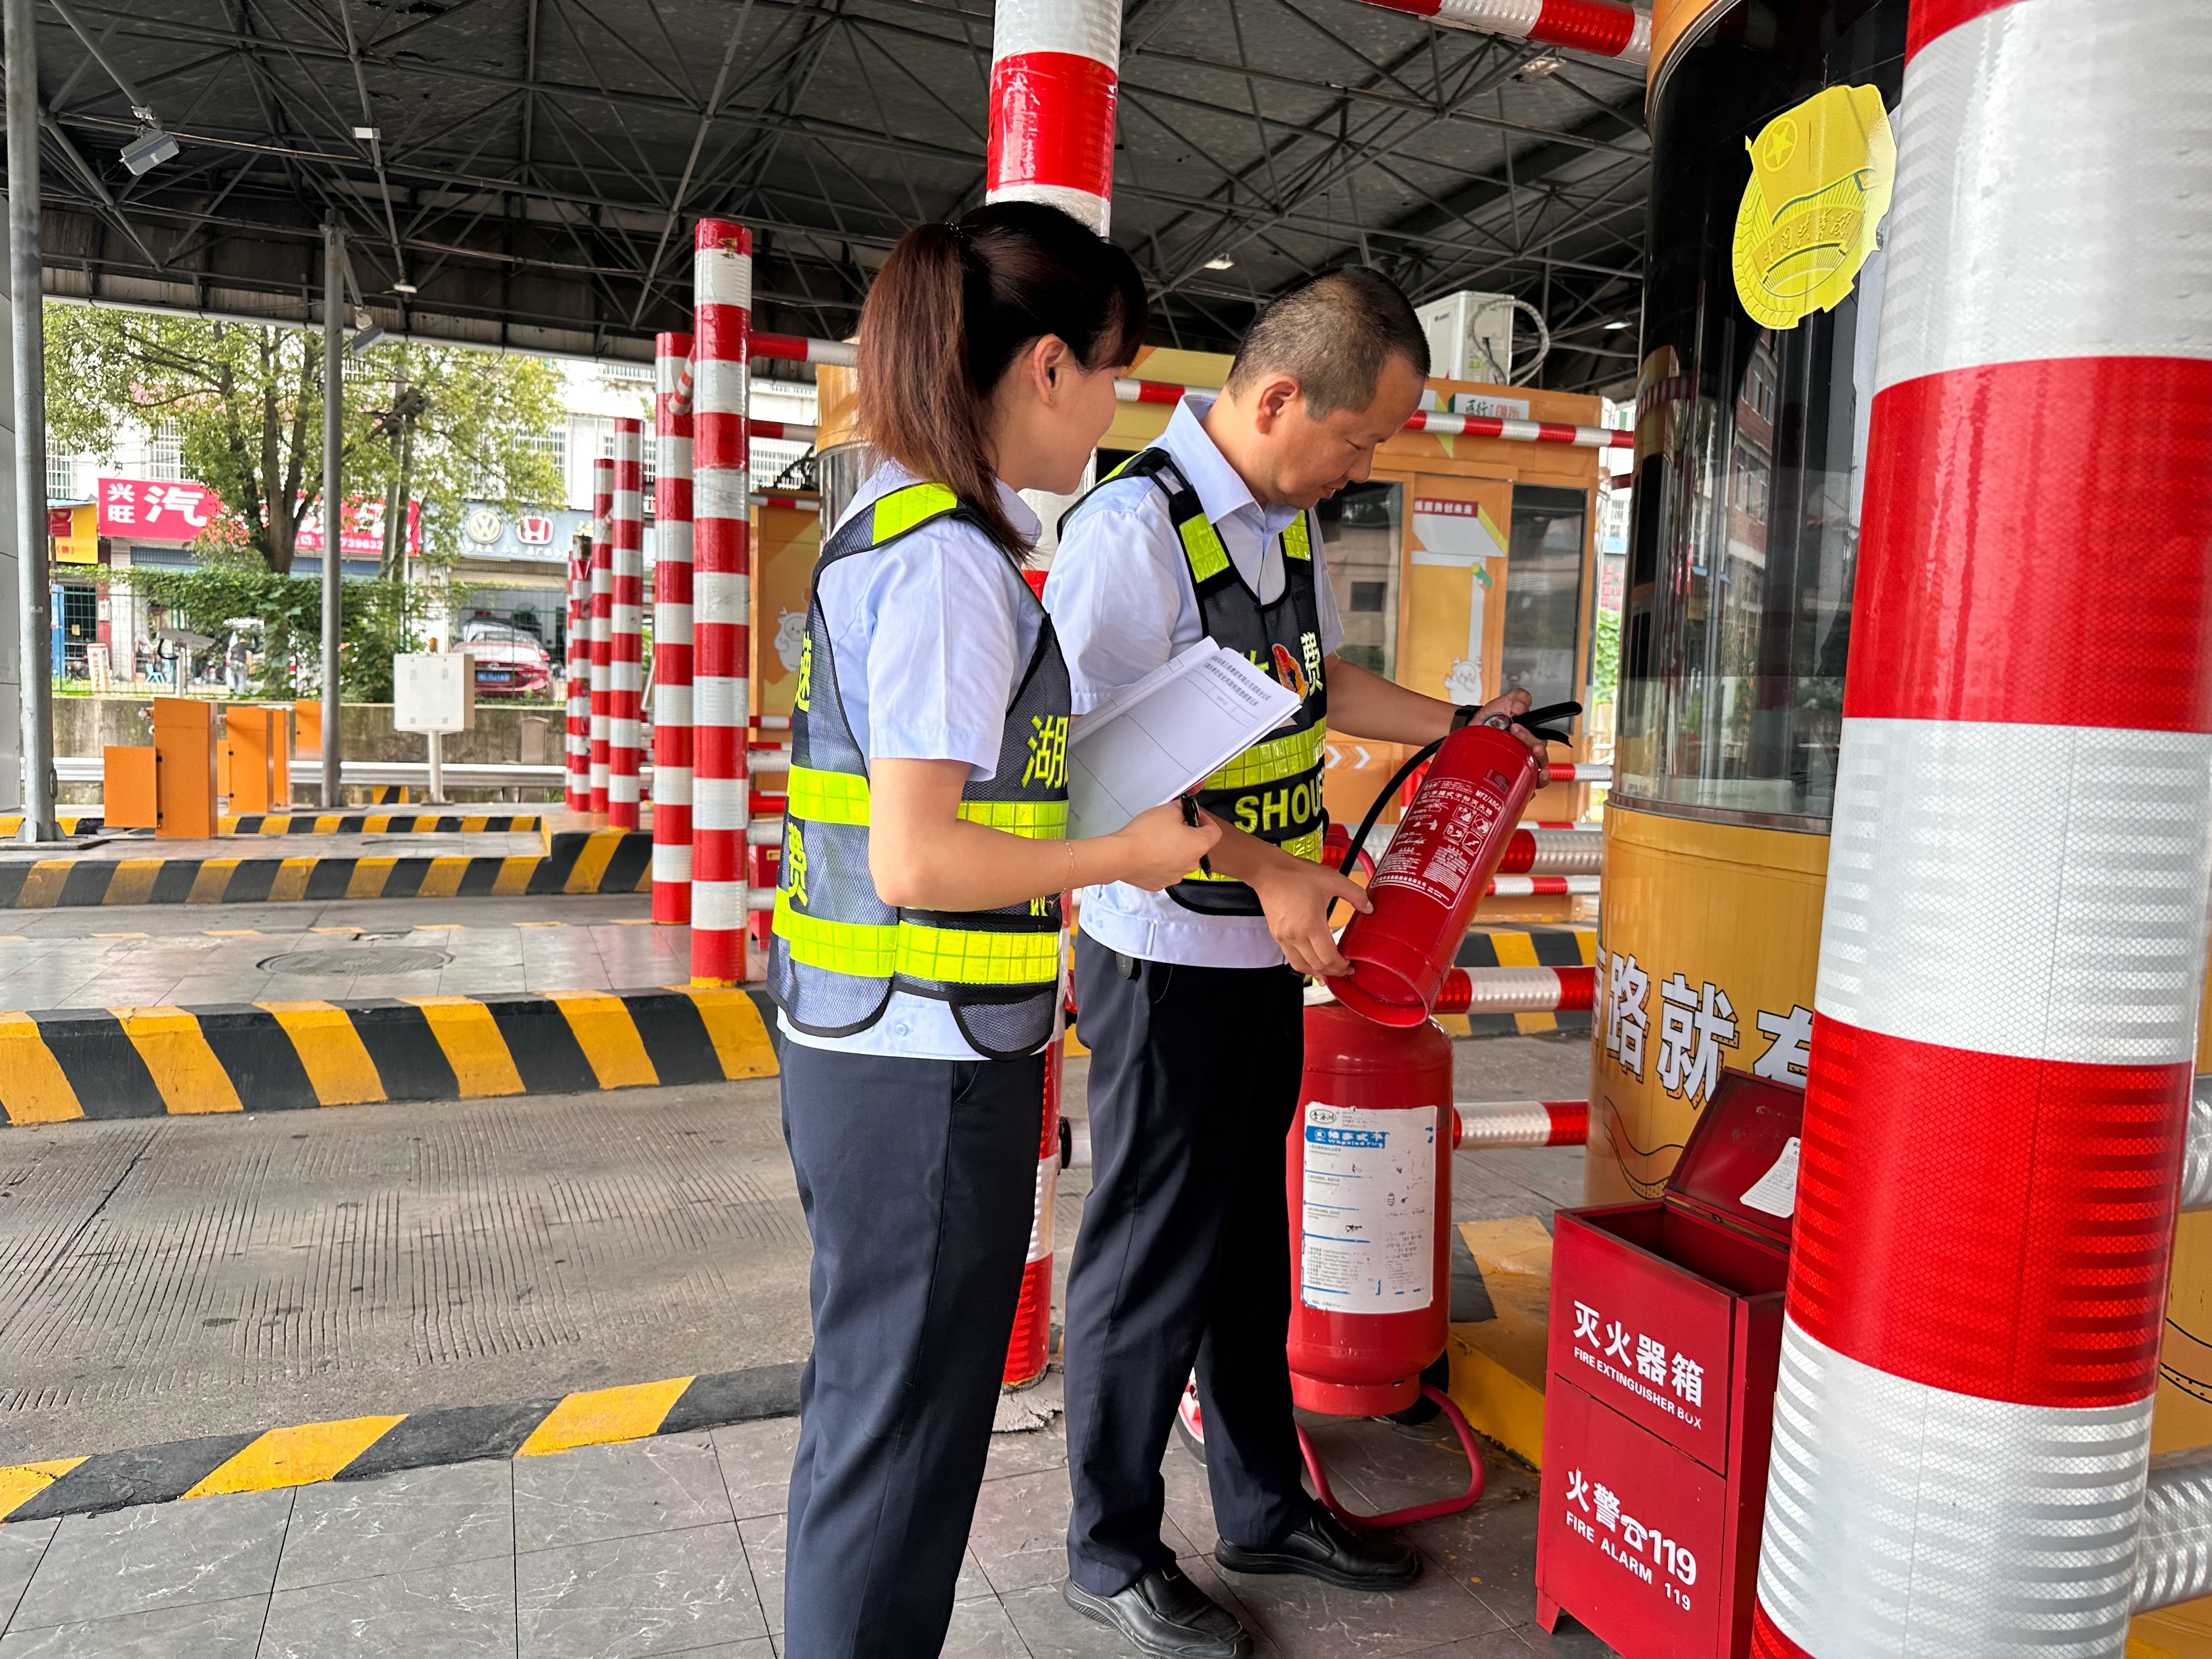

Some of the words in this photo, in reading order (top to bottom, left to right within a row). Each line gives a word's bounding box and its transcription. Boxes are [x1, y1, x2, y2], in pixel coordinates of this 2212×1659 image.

[107, 483, 136, 524] 兴旺
[144, 486, 207, 527] 汽
[1022, 715, 1069, 789] 湖
[1573, 1300, 1704, 1408] 灭火器箱
[1574, 1346, 1595, 1368] FIRE
[1596, 1359, 1675, 1415] EXTINGUISHER
[1677, 1406, 1702, 1430] BOX
[1566, 1469, 1620, 1533] 火警
[1649, 1530, 1697, 1585] 119
[1566, 1510, 1595, 1543] FIRE
[1600, 1537, 1652, 1585] ALARM
[1664, 1583, 1691, 1611] 119
